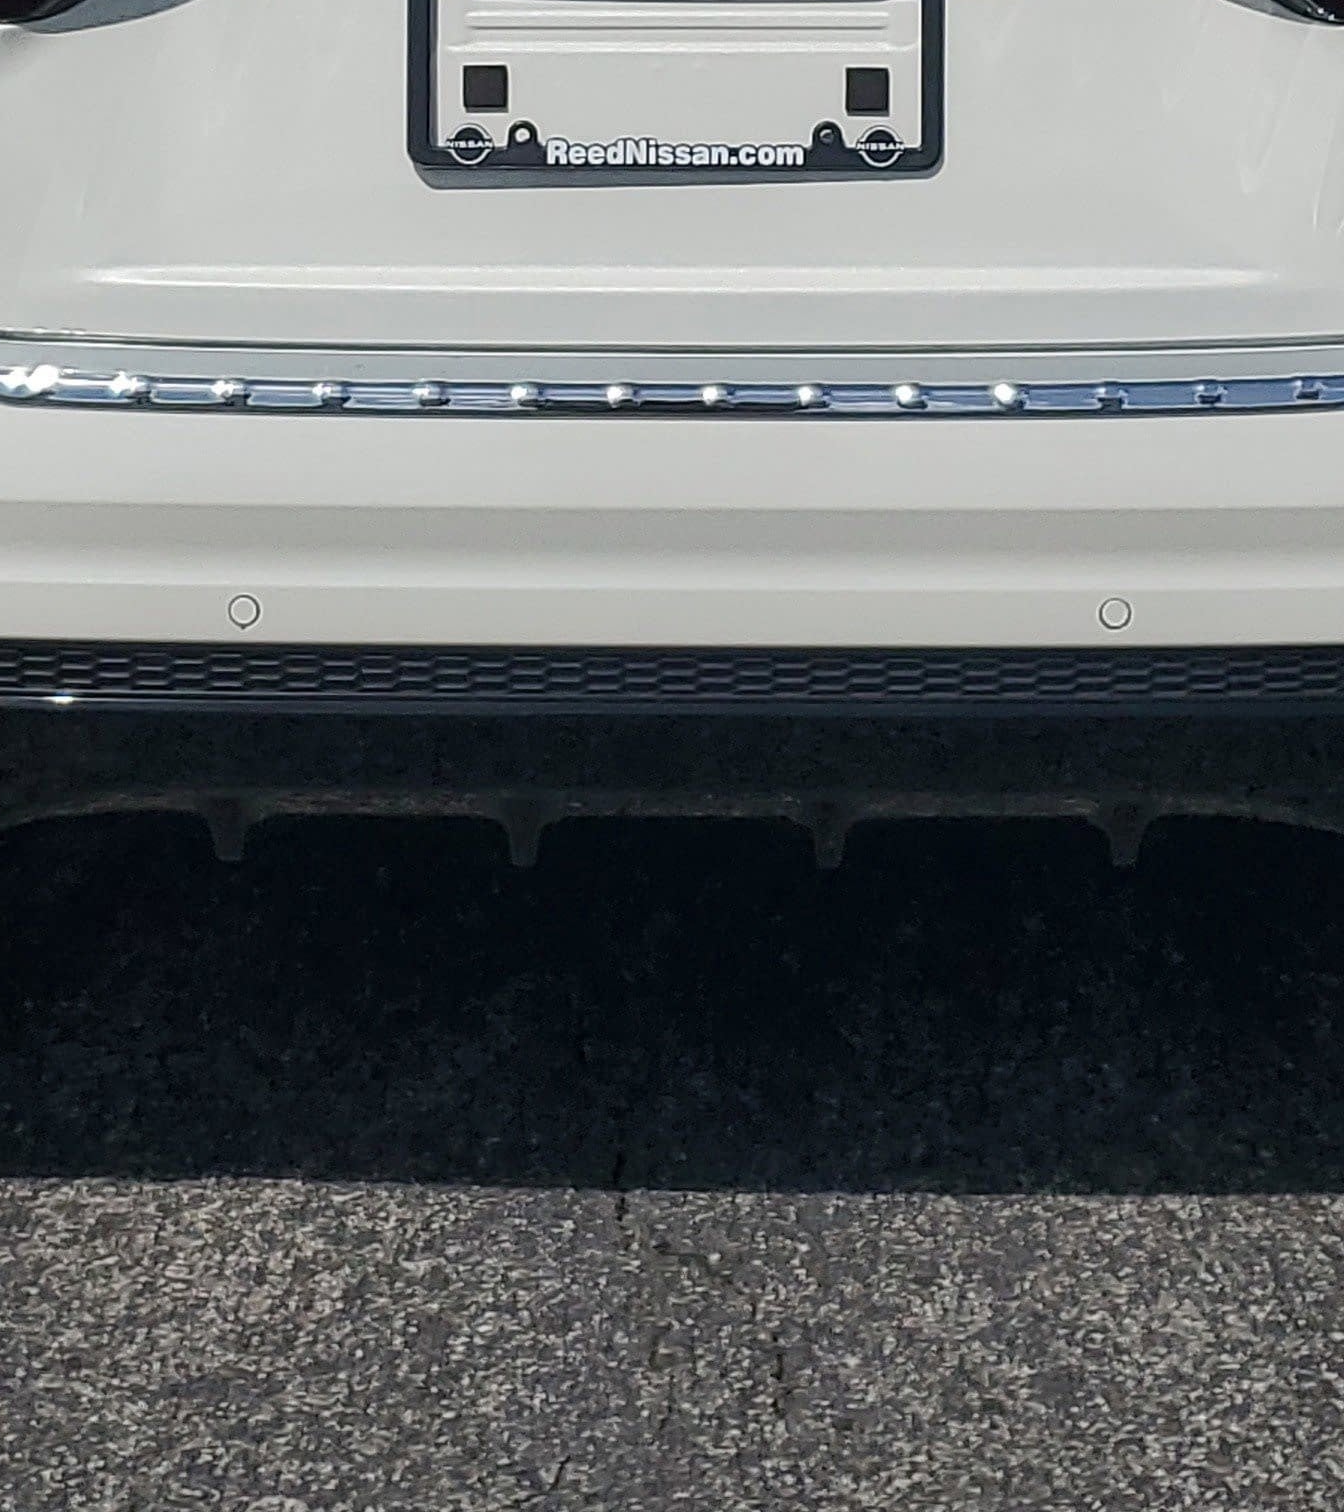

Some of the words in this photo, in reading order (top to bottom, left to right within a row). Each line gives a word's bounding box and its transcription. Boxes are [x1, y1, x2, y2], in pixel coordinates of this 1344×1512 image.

[446, 139, 494, 149] NISSAN
[856, 141, 905, 152] NISSAN
[545, 137, 805, 166] ReedNissan.com
